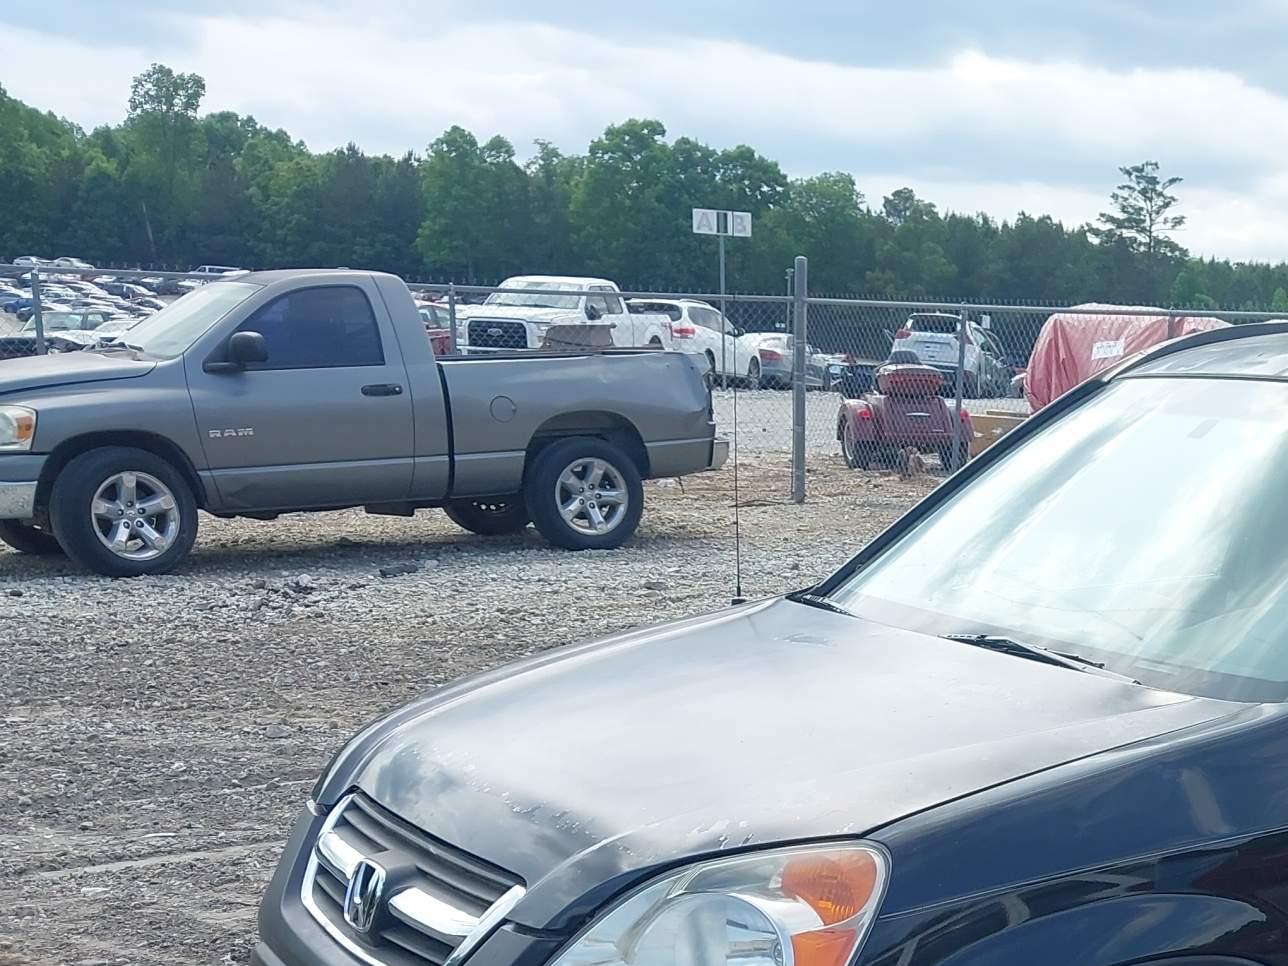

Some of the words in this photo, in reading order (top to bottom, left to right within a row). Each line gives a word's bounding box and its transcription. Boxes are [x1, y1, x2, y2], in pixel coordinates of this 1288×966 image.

[696, 211, 713, 233] A
[734, 214, 747, 233] B
[208, 427, 254, 438] RAM
